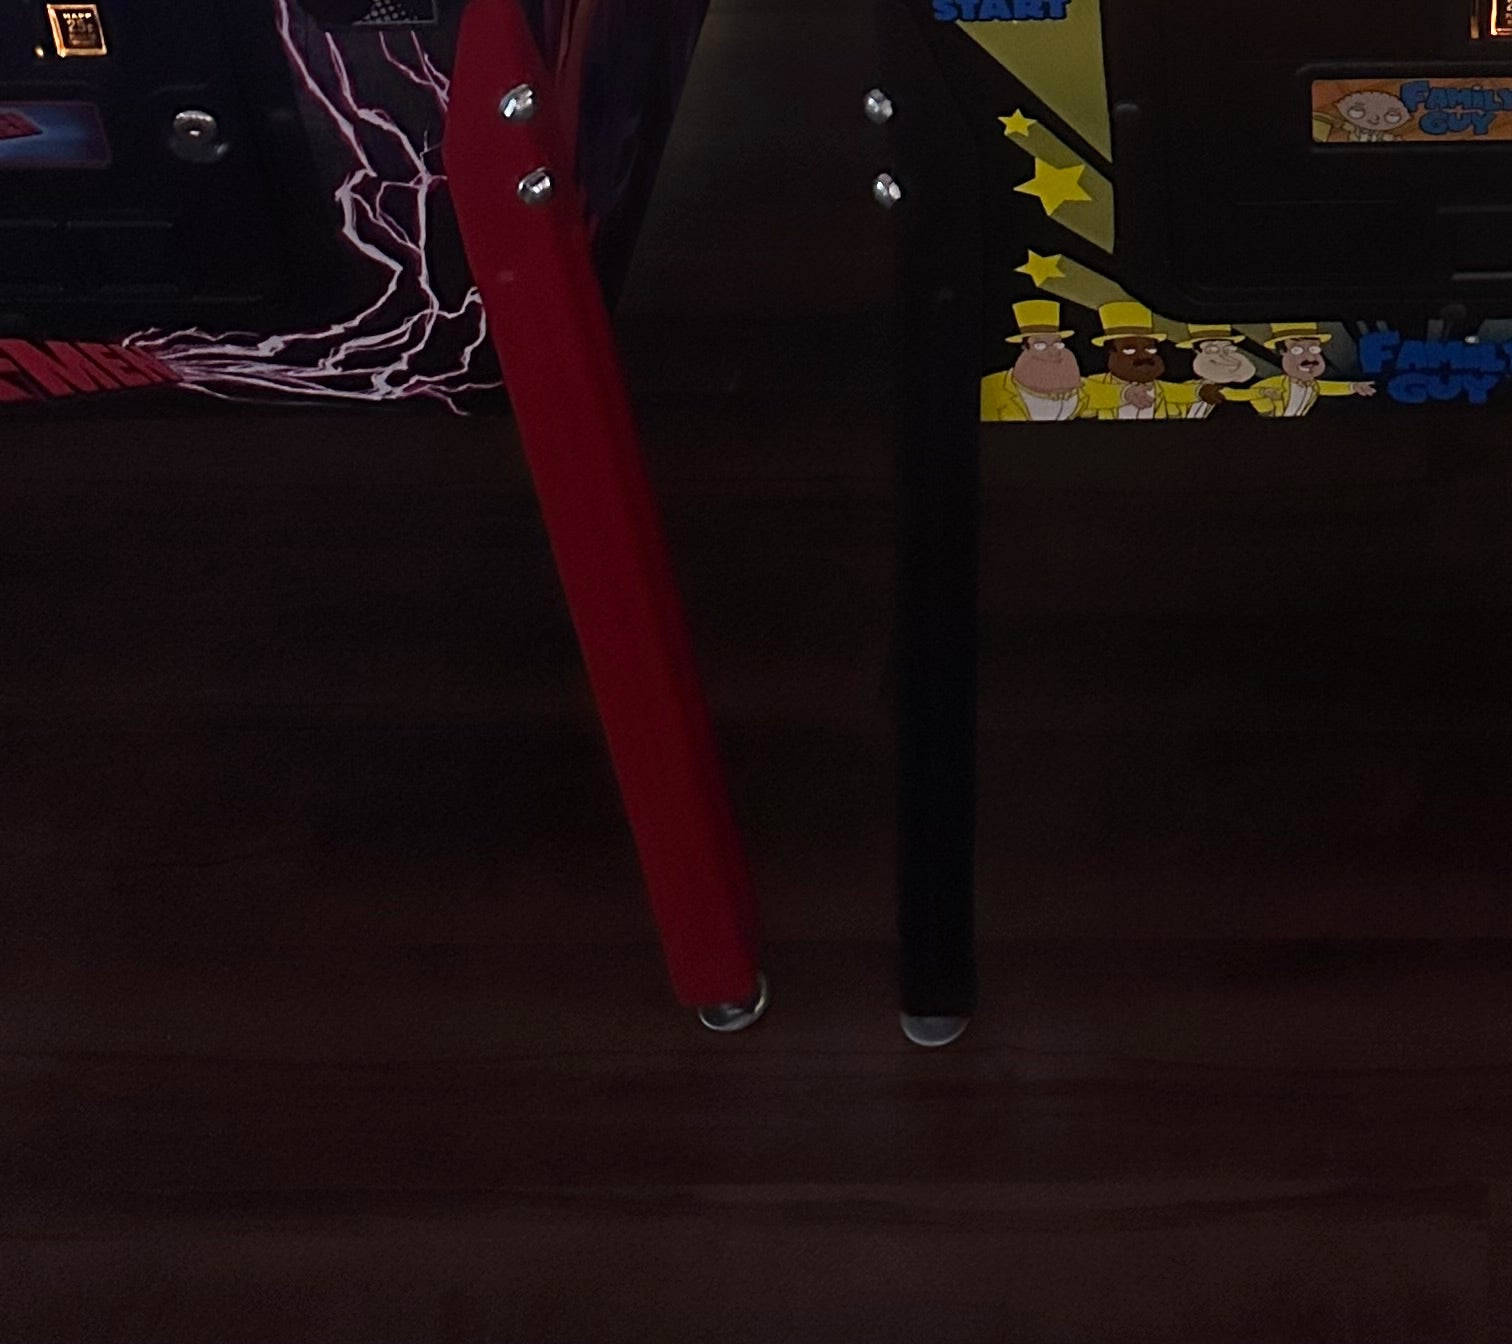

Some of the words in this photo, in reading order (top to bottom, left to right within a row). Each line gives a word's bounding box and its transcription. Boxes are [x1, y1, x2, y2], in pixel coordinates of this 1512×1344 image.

[1419, 111, 1497, 136] GUY
[0, 338, 184, 401] -MEN
[1387, 372, 1500, 405] GUY
